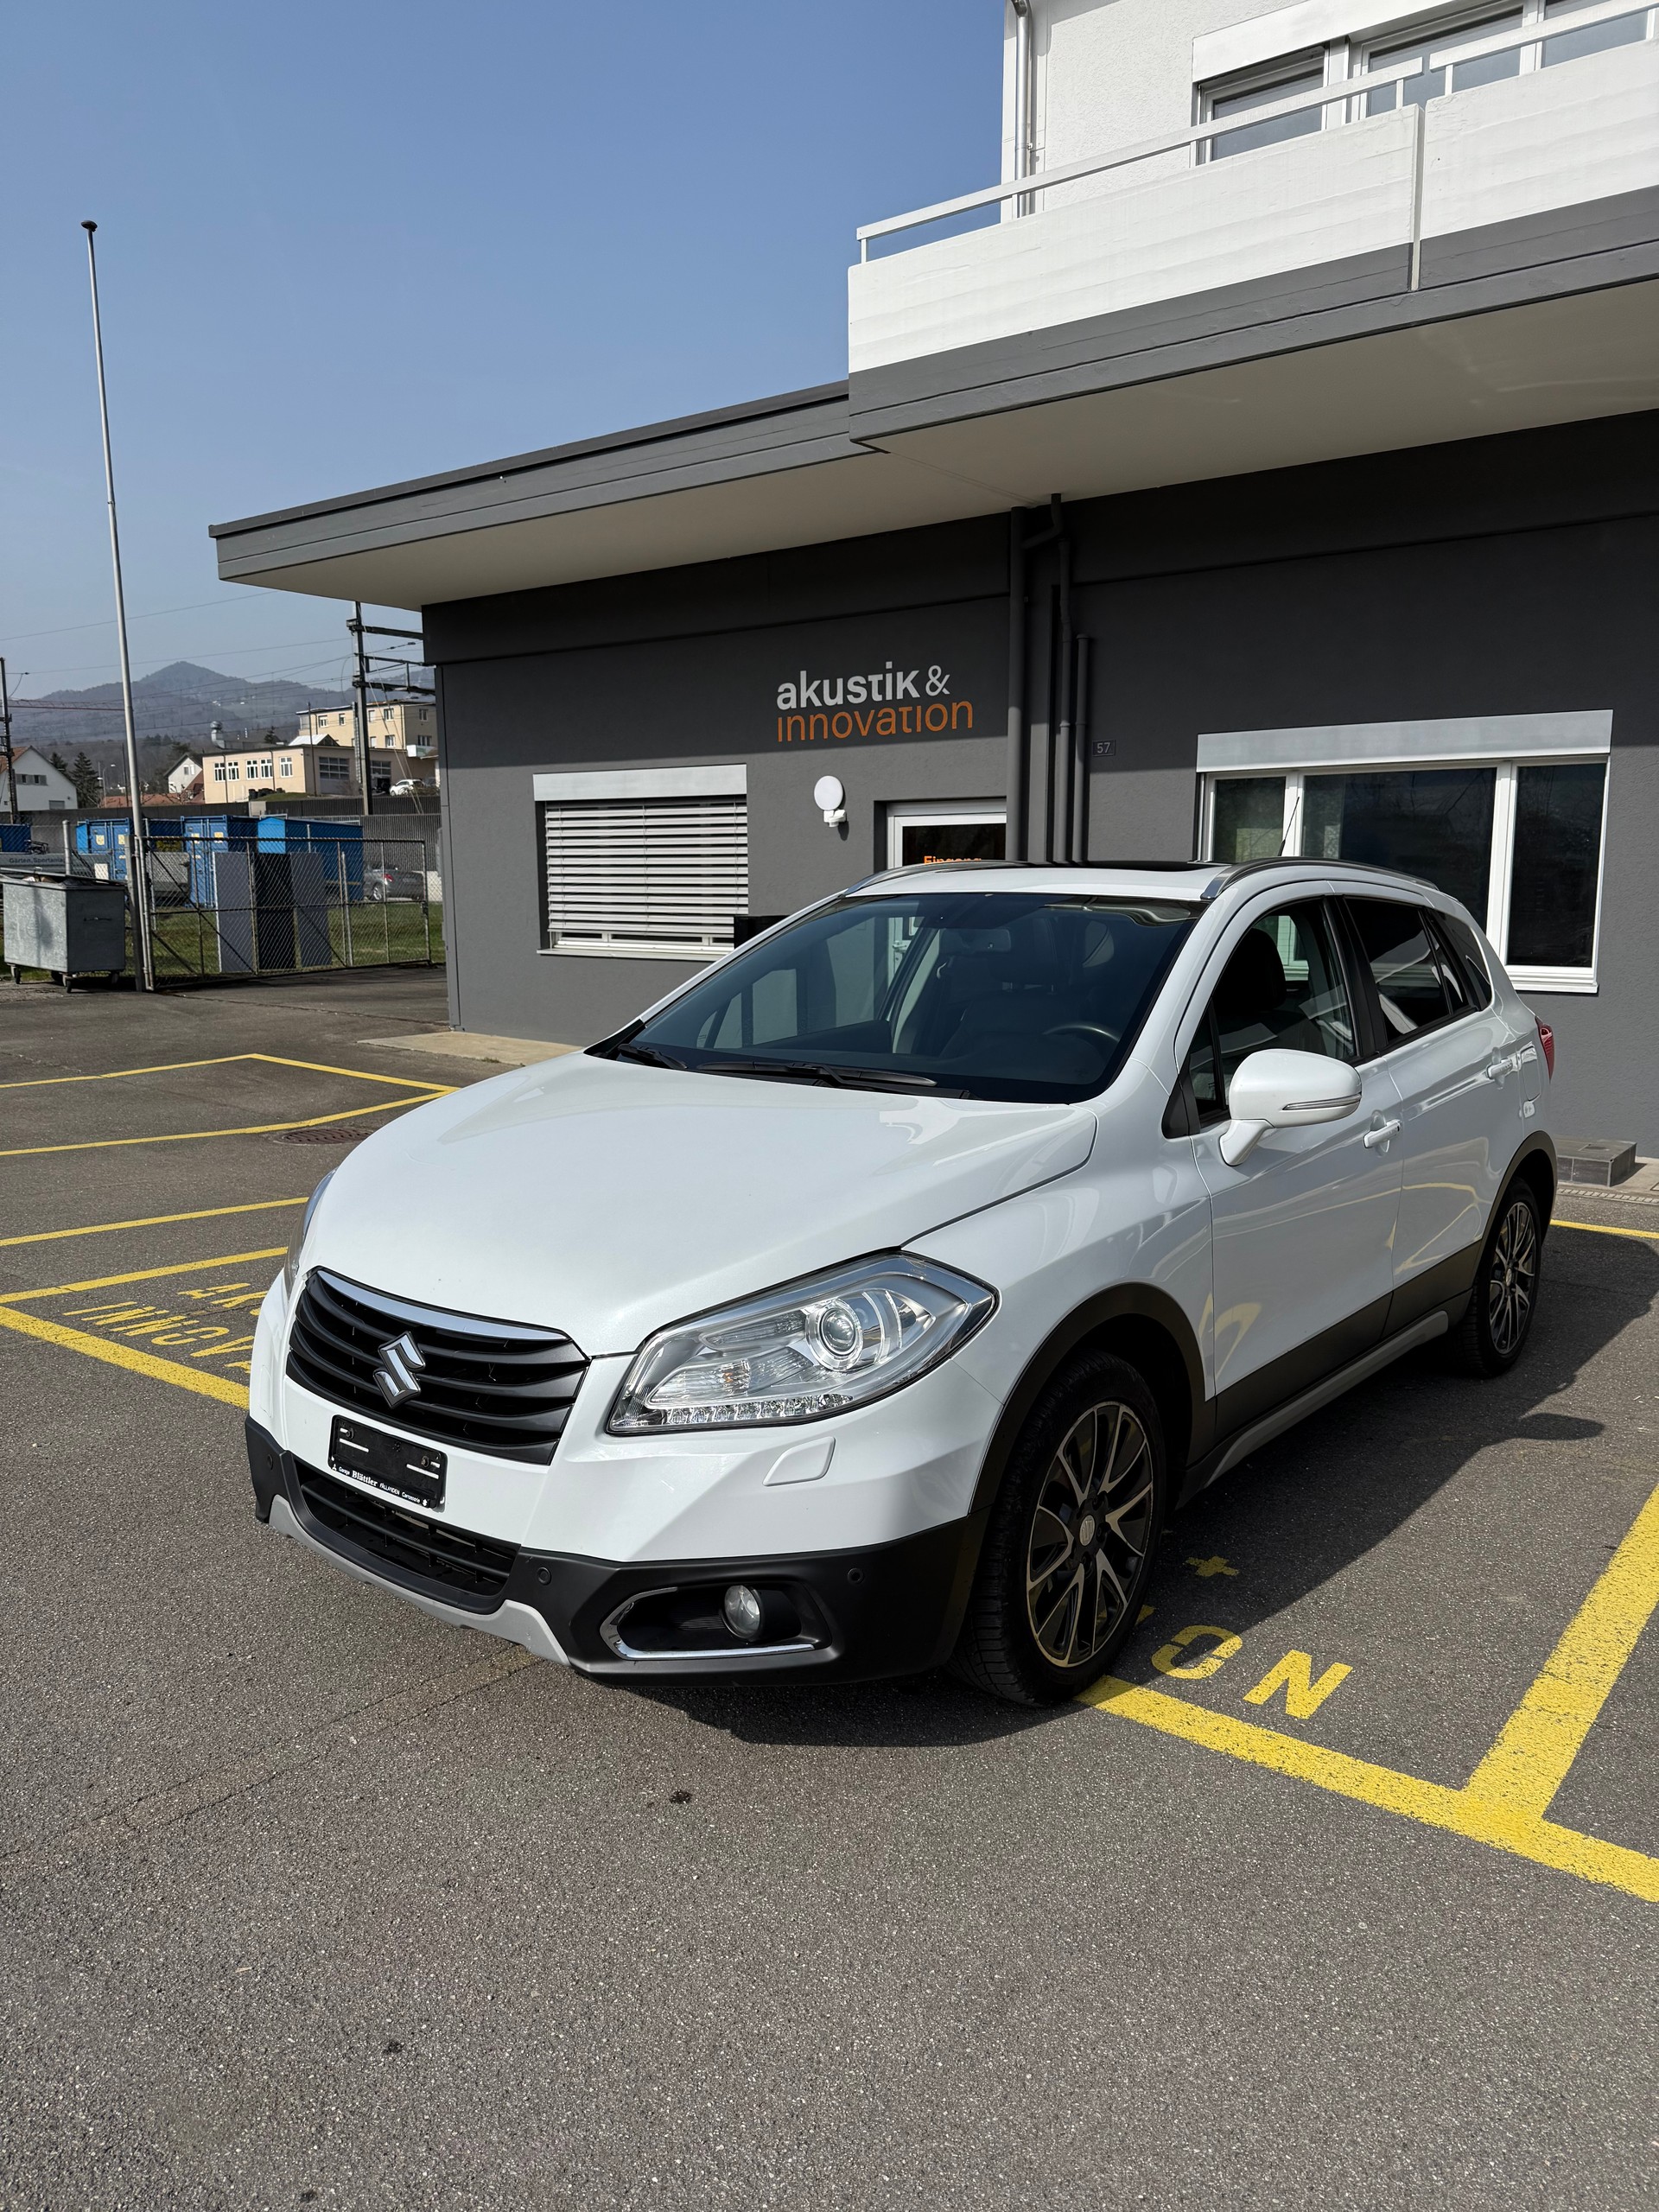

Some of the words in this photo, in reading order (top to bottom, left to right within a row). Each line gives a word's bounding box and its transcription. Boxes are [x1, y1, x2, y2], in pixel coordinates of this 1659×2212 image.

[777, 661, 919, 710] akustik
[925, 664, 950, 696] &
[777, 700, 974, 743] innovation
[1096, 741, 1111, 754] 57
[352, 1470, 378, 1487] Blättler
